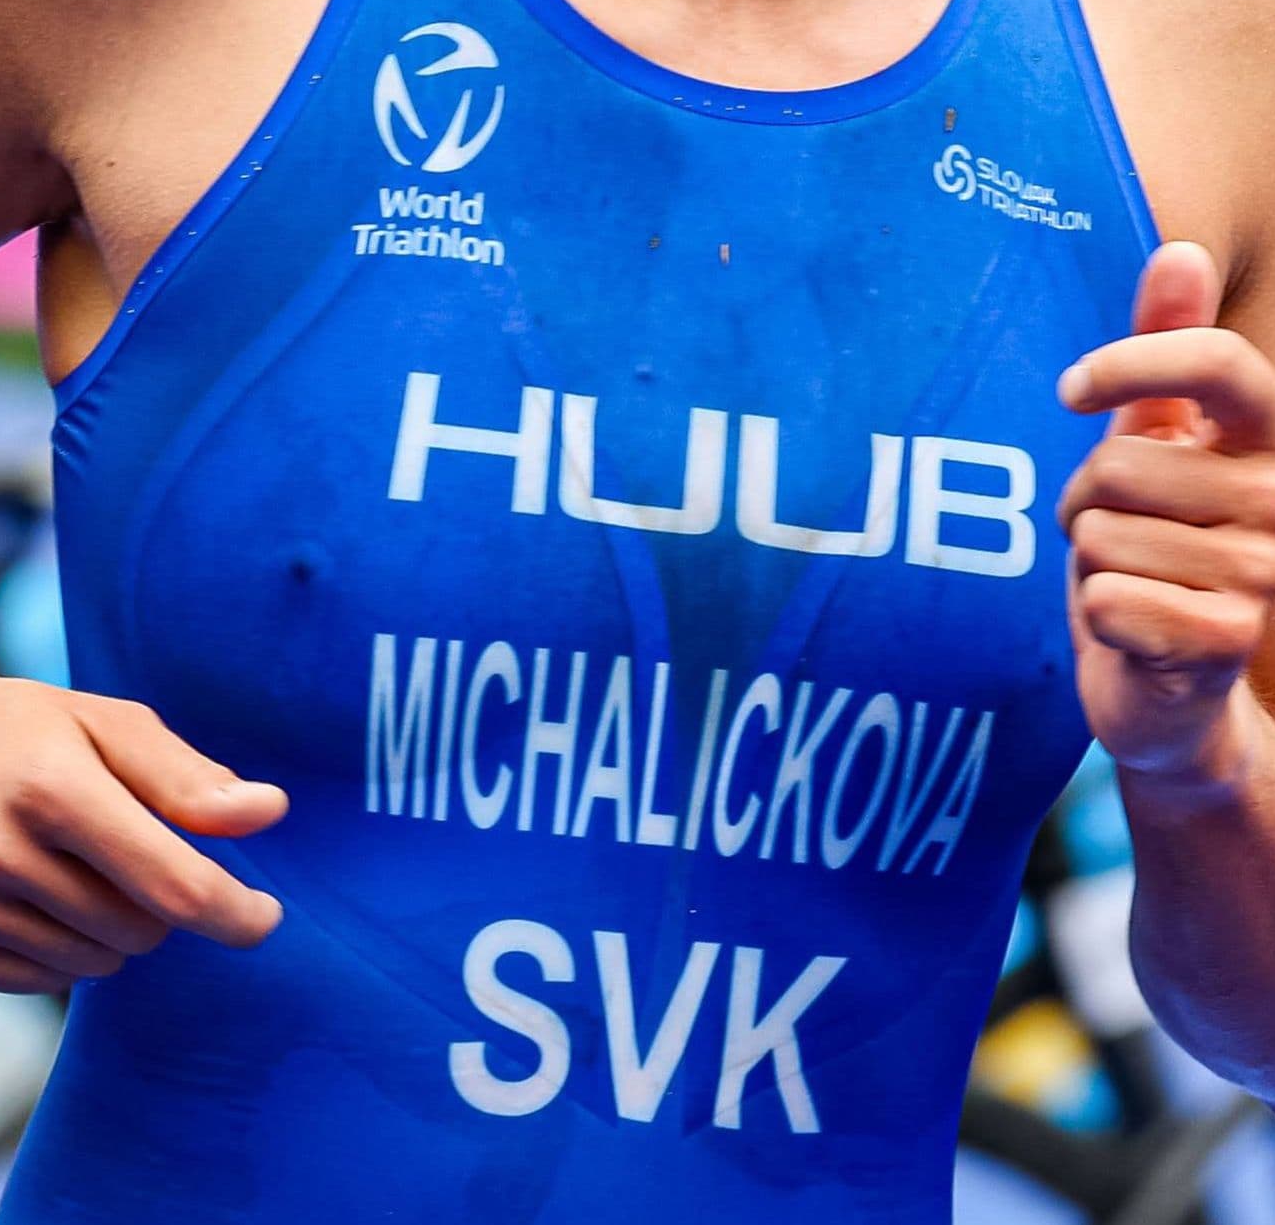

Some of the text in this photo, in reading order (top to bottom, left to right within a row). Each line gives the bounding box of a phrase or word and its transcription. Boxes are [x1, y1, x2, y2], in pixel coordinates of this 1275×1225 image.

[351, 223, 506, 266] Triathlon
[378, 186, 485, 225] World
[387, 372, 1036, 578] HUUB
[366, 632, 995, 877] MICHALICKOVA
[448, 918, 848, 1135] SVK
